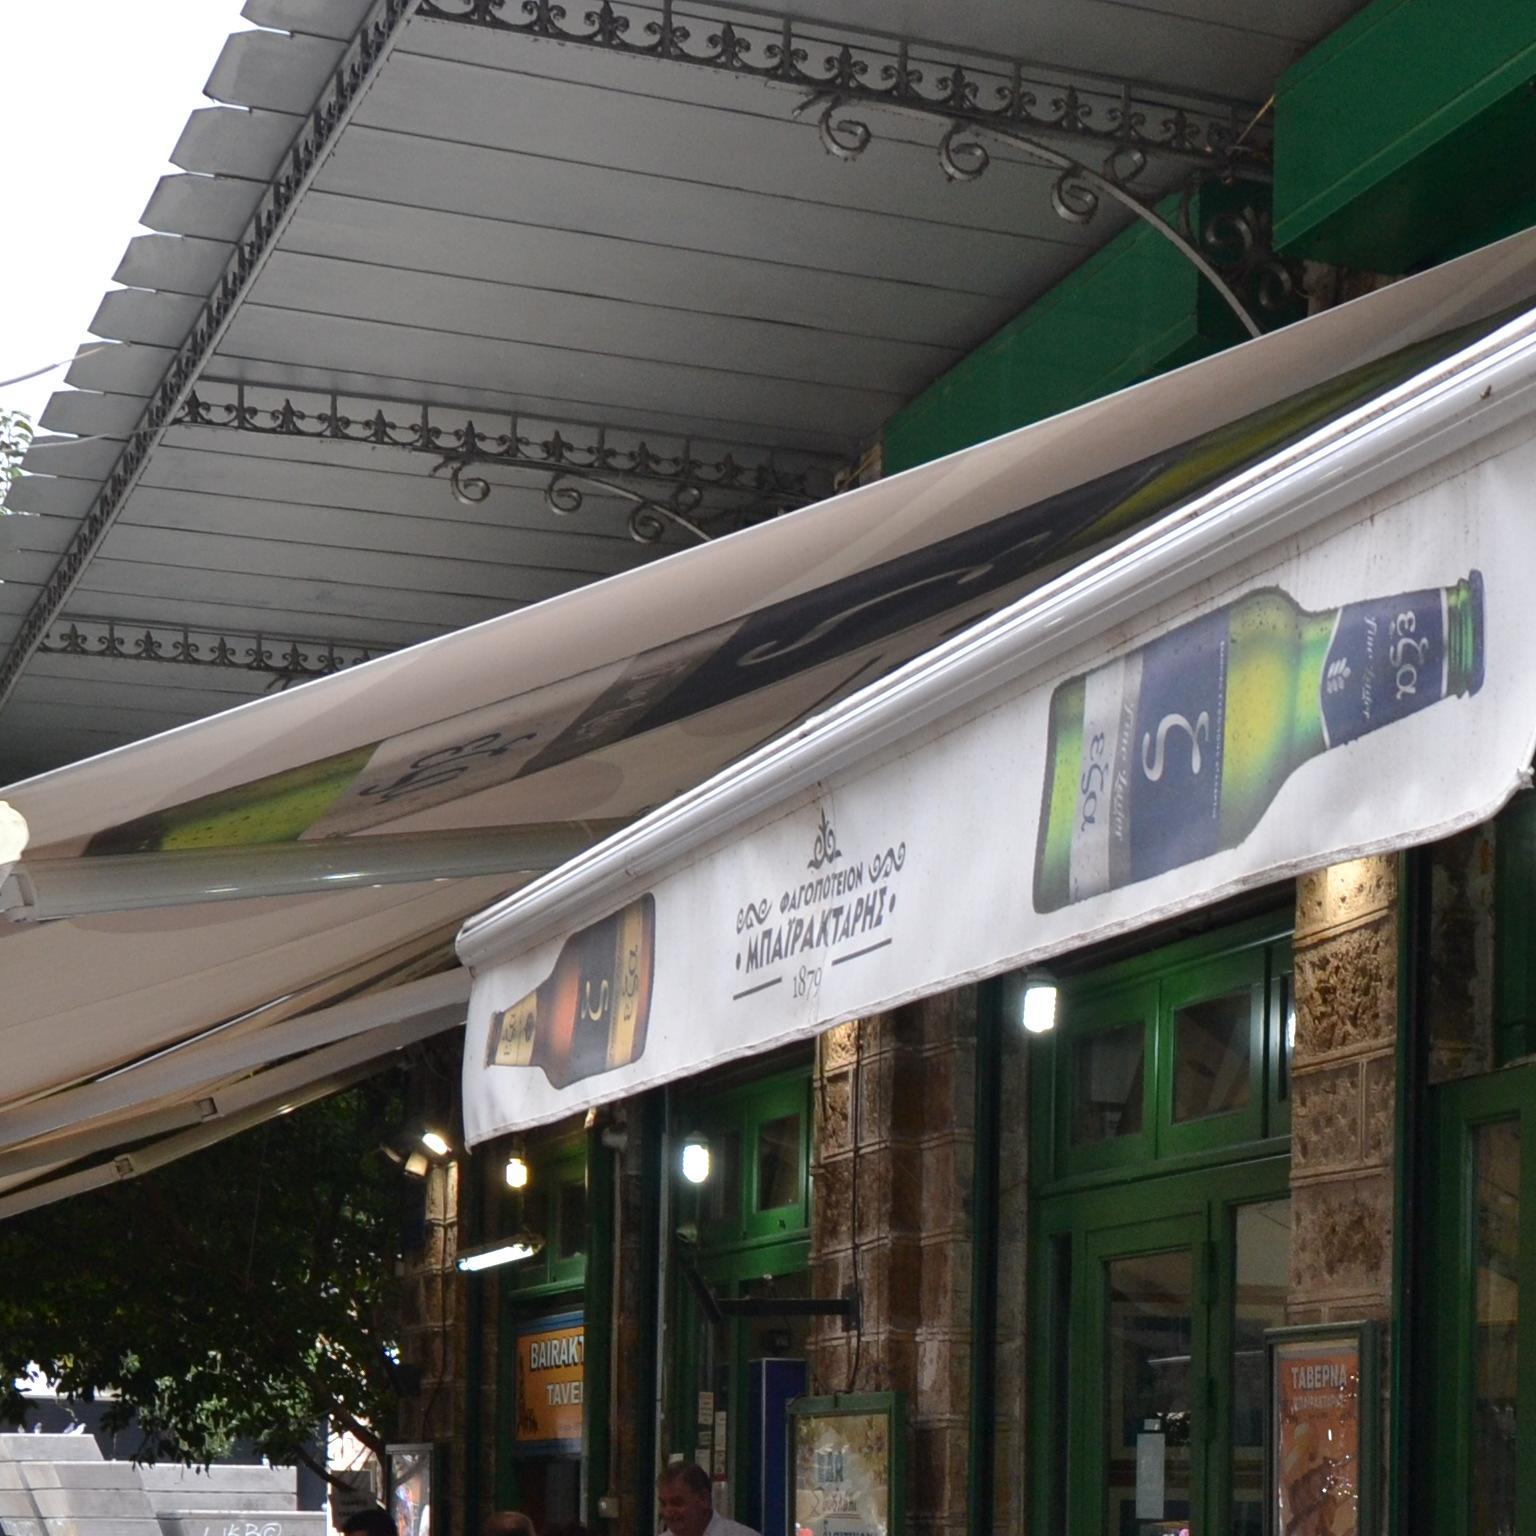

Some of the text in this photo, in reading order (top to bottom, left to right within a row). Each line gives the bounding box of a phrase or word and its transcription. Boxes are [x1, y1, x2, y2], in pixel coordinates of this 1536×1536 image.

[779, 861, 864, 915] ΦΑΓΟΠΟΤΕΙΟΝ
[745, 885, 888, 974] ΜΠΑΪΡΑΚΤΑΡΗΣ
[792, 963, 824, 1000] 1879
[1291, 1364, 1348, 1390] ΤΑΒΕΡΝΑ
